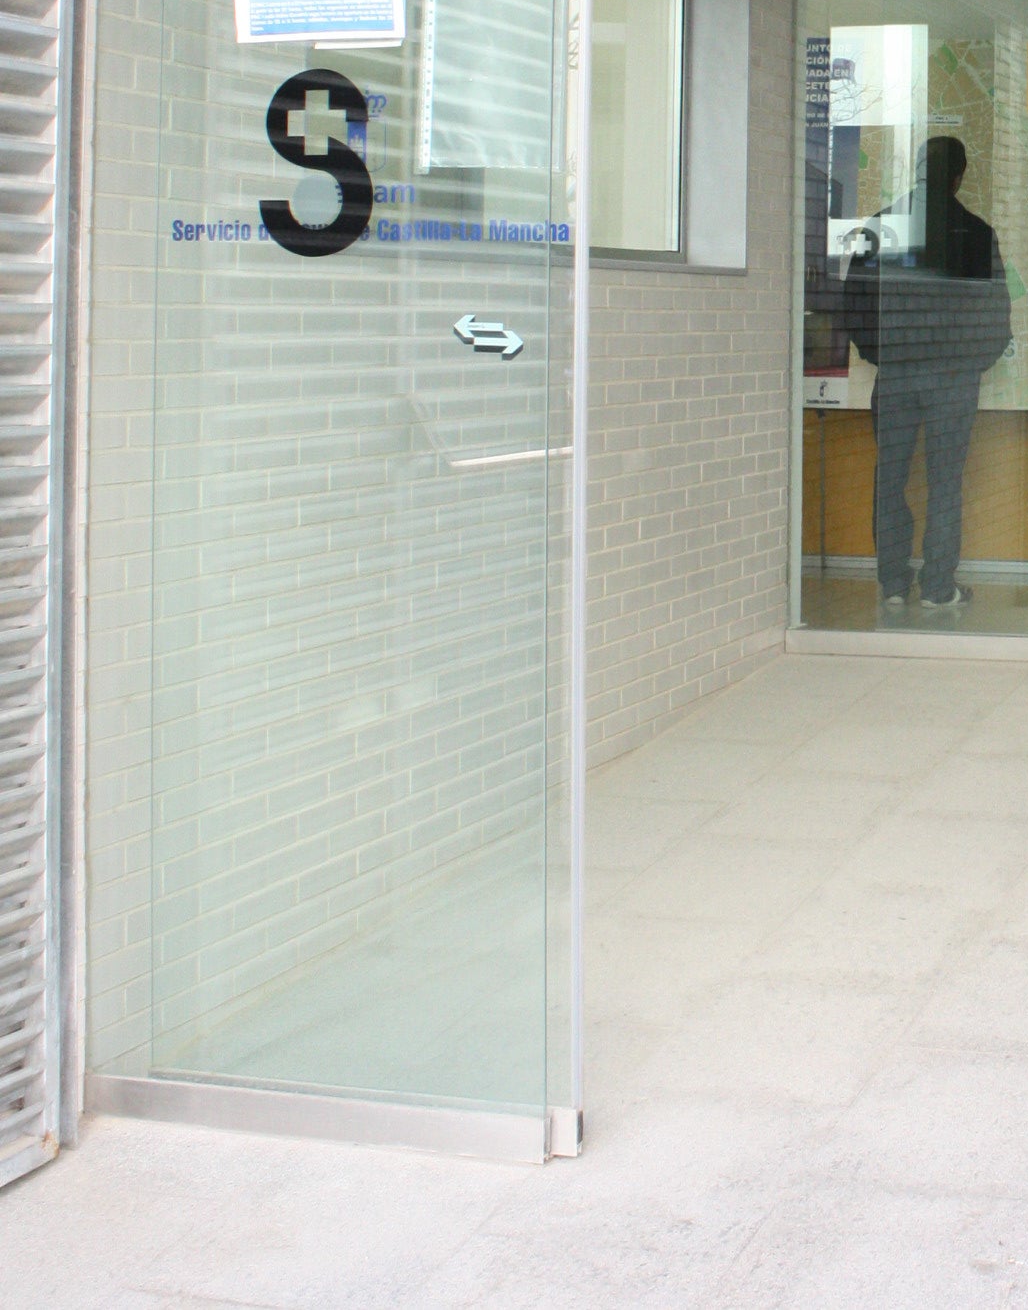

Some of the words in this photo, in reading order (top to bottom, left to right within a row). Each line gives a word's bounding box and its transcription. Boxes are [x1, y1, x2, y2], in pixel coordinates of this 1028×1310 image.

[172, 219, 251, 241] Servicio
[377, 218, 484, 241] Castilla-La
[488, 218, 570, 242] Mancha
